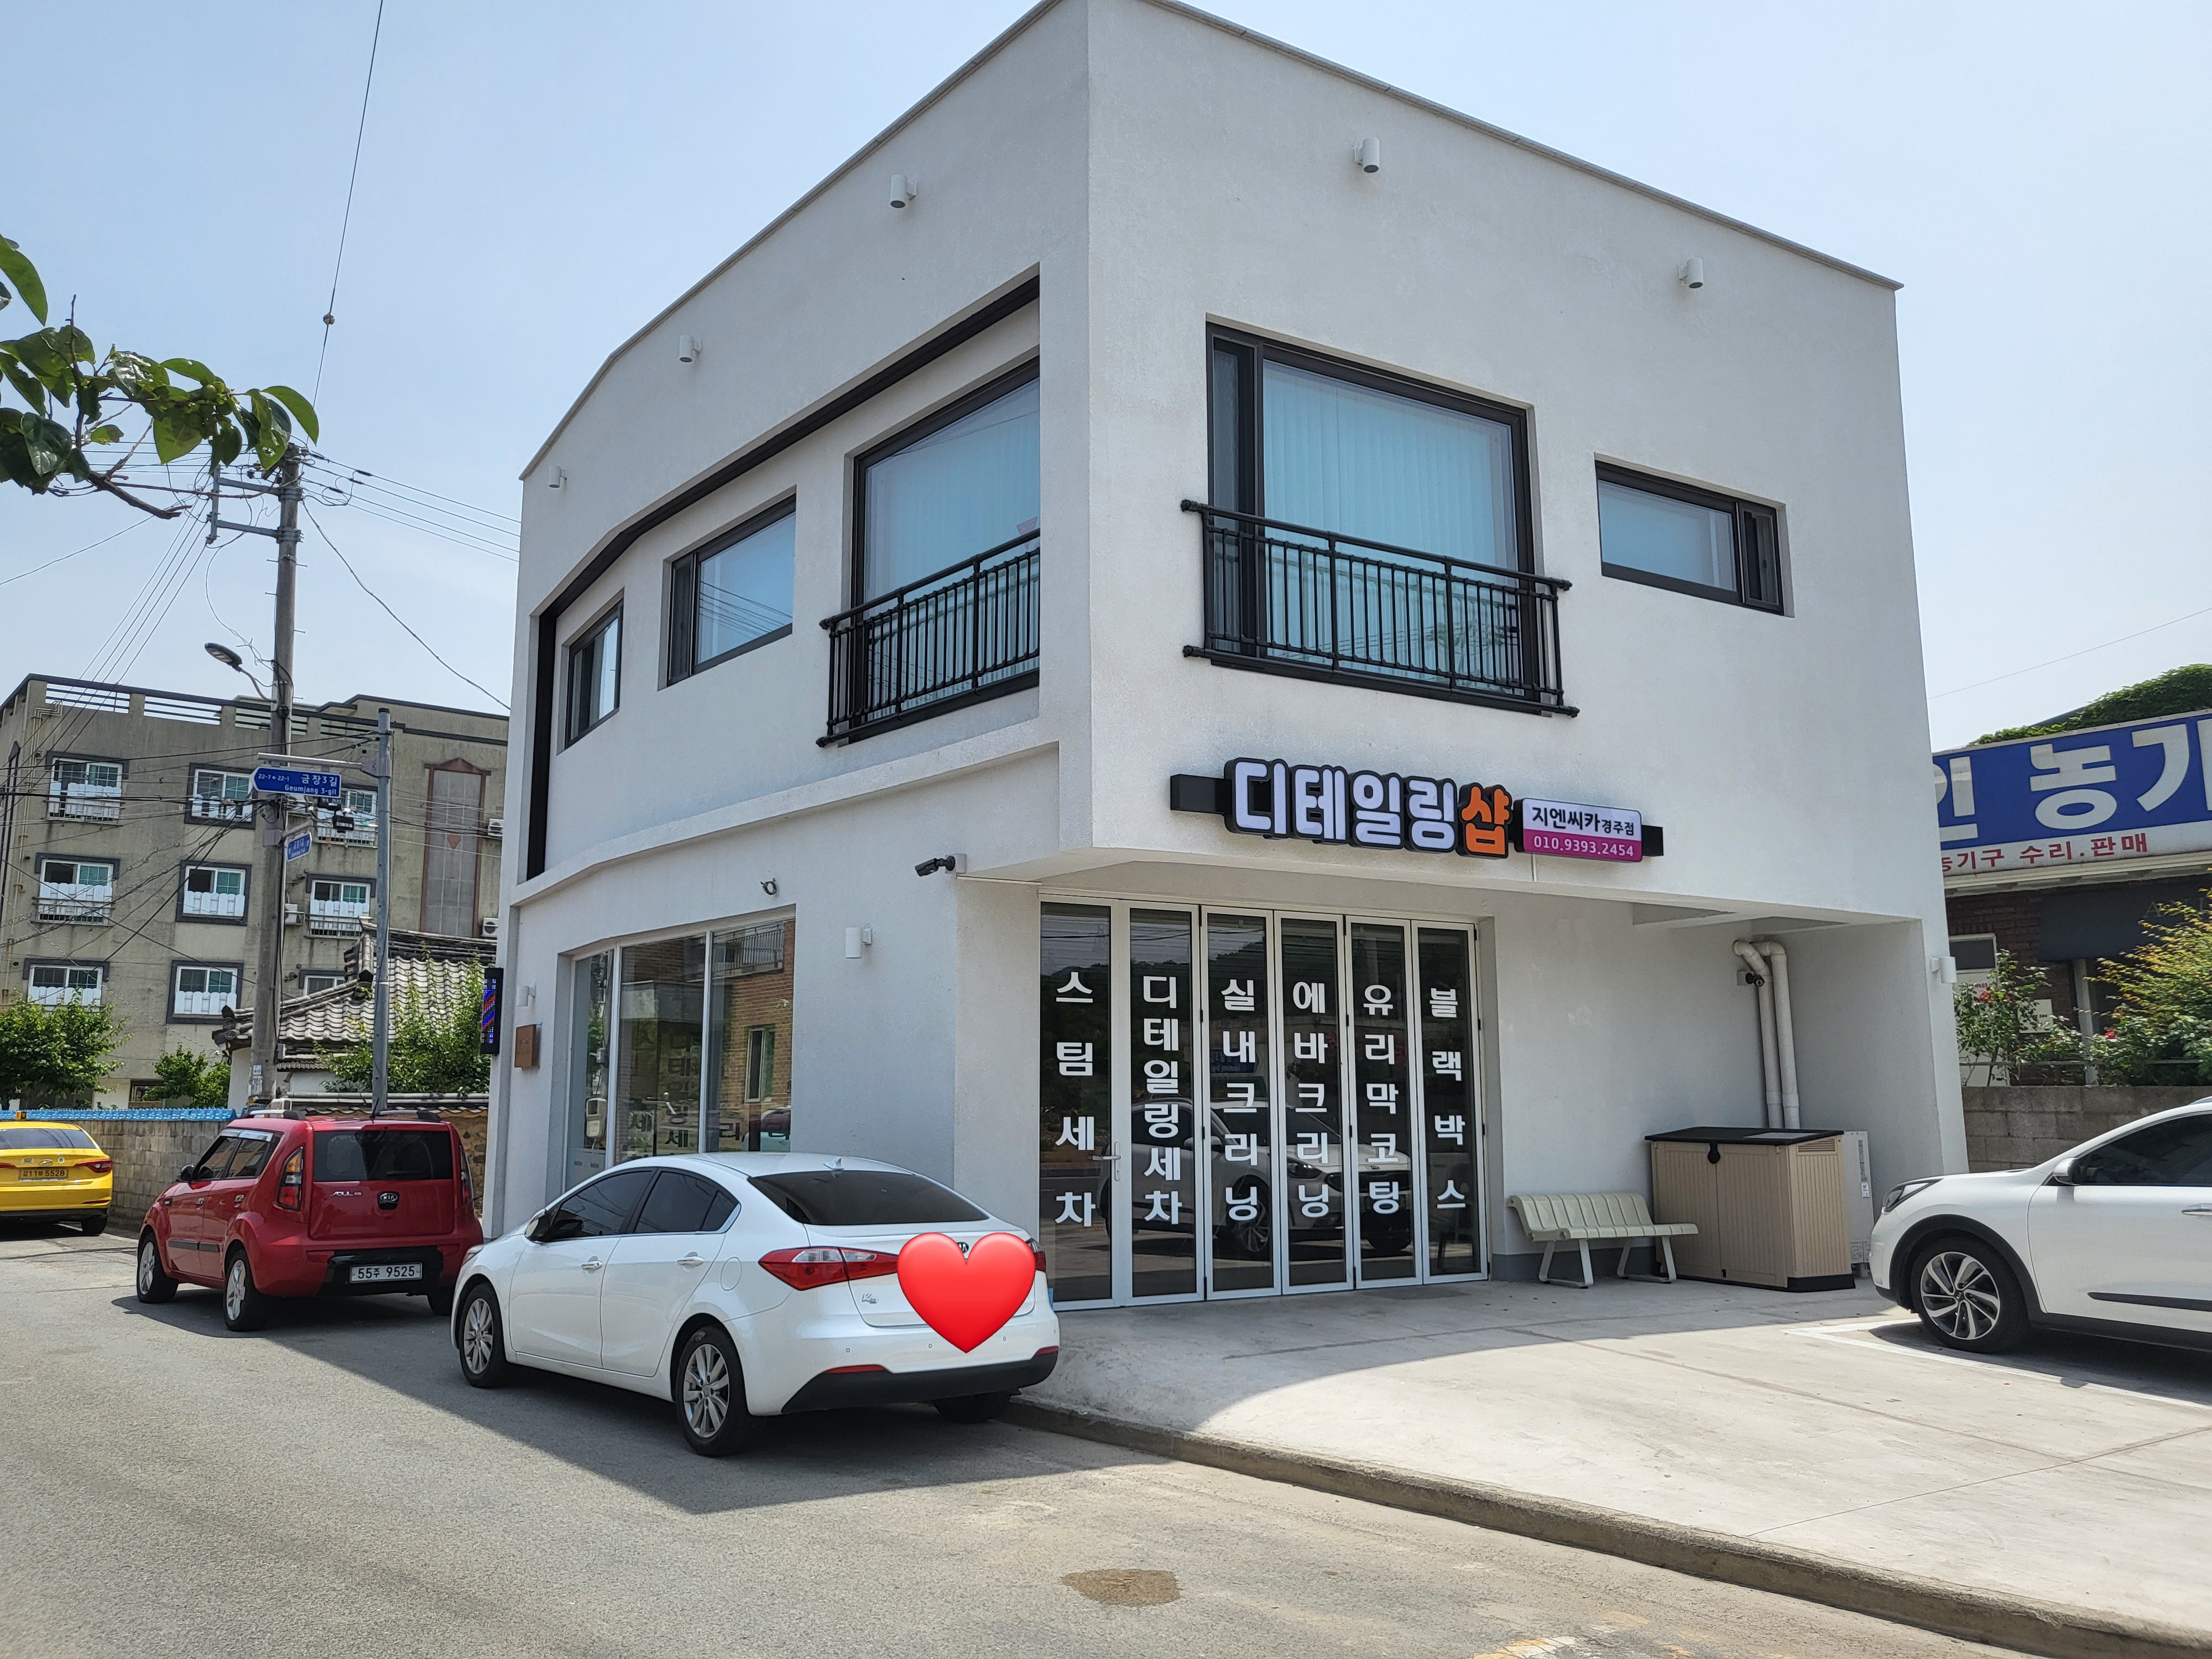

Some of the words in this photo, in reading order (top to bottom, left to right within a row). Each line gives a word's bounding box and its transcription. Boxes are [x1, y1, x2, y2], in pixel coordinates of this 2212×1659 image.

[284, 784, 319, 794] Geumjang
[301, 774, 337, 787] 금장3길
[1235, 761, 1510, 855] 디테일링샵
[1533, 836, 1634, 857] 010.9393.2454
[1055, 972, 1096, 1227] 스팀세차
[1143, 975, 1182, 1225] 디테일링세차
[1221, 979, 1258, 1221] 실내크리닝
[1292, 982, 1329, 1217] 에바크리닝
[1363, 984, 1400, 1215] 유리막코팅
[1430, 988, 1467, 1209] 블랙박스
[358, 1267, 380, 1279] 55주
[386, 1266, 415, 1278] 9525
